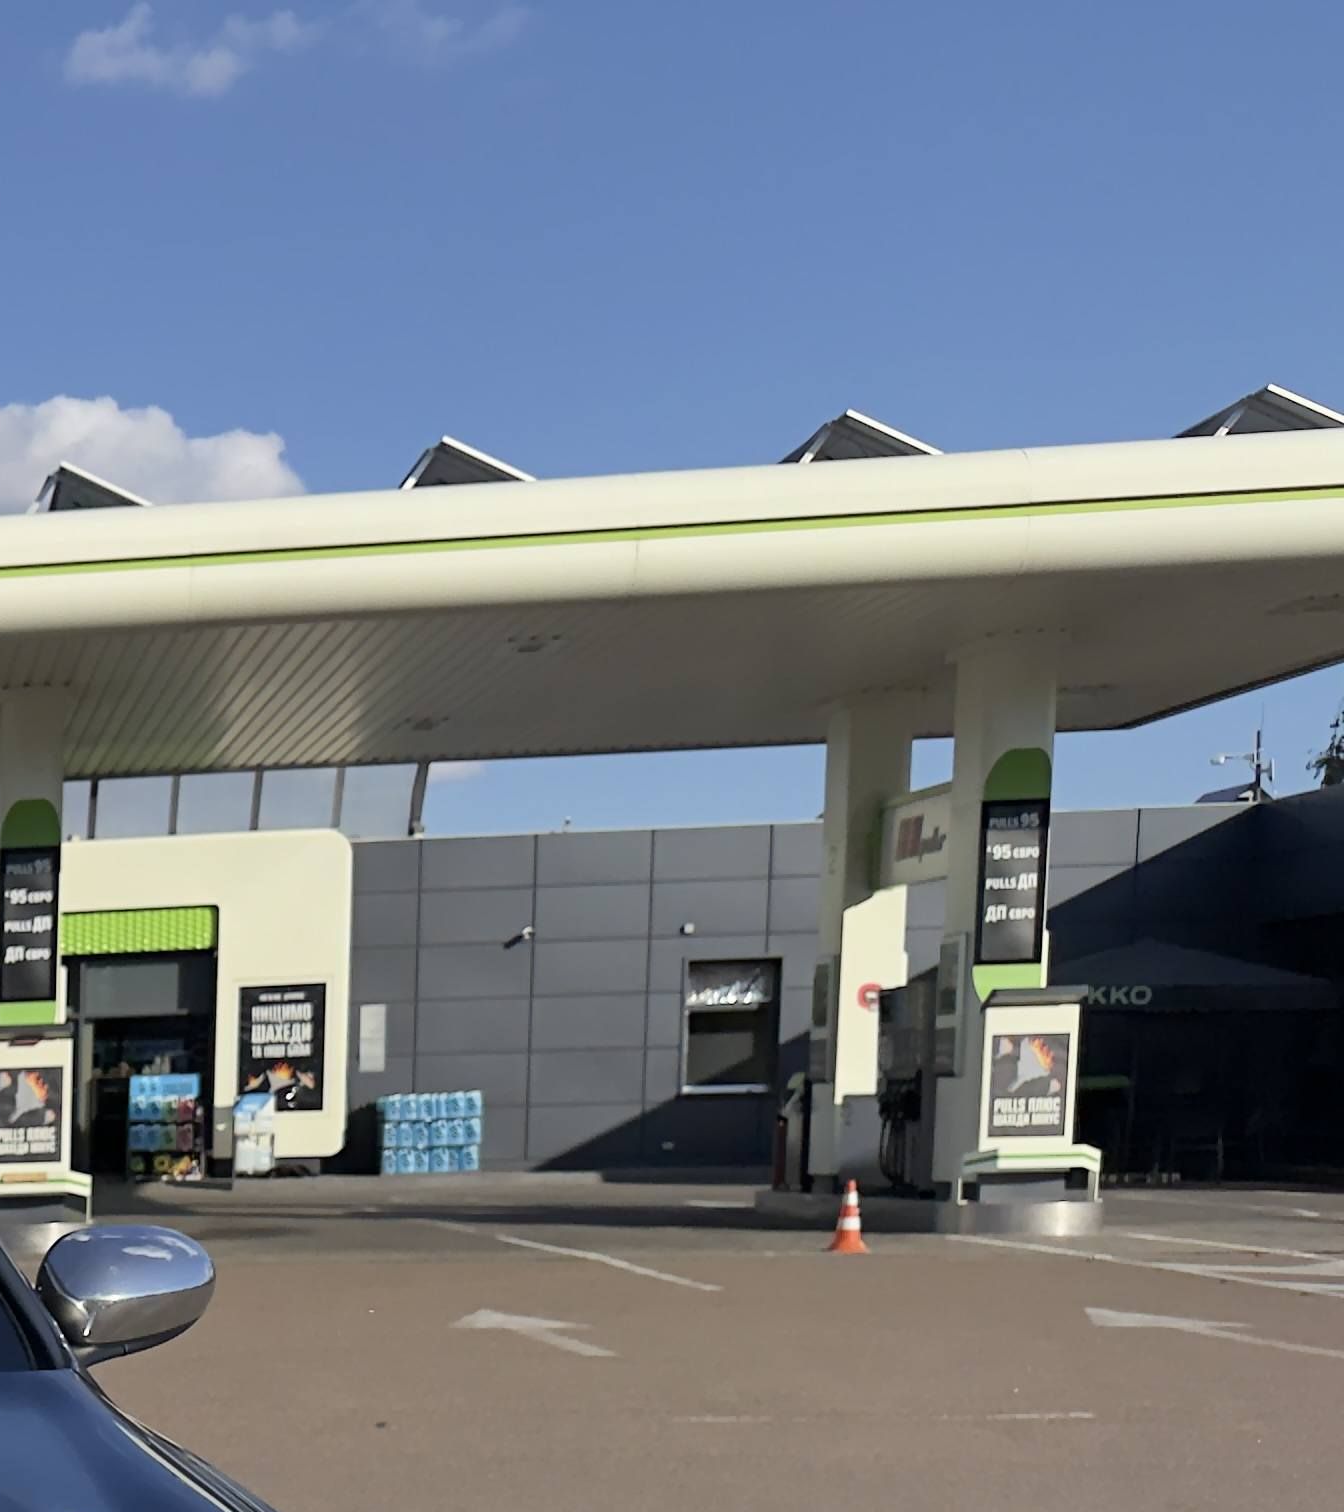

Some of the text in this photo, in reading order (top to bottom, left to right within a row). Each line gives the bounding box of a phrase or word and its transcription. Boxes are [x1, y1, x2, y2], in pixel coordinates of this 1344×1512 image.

[1020, 812, 1039, 828] 95
[1088, 985, 1152, 1005] KKO
[251, 1021, 312, 1044] ШАХЕДИ
